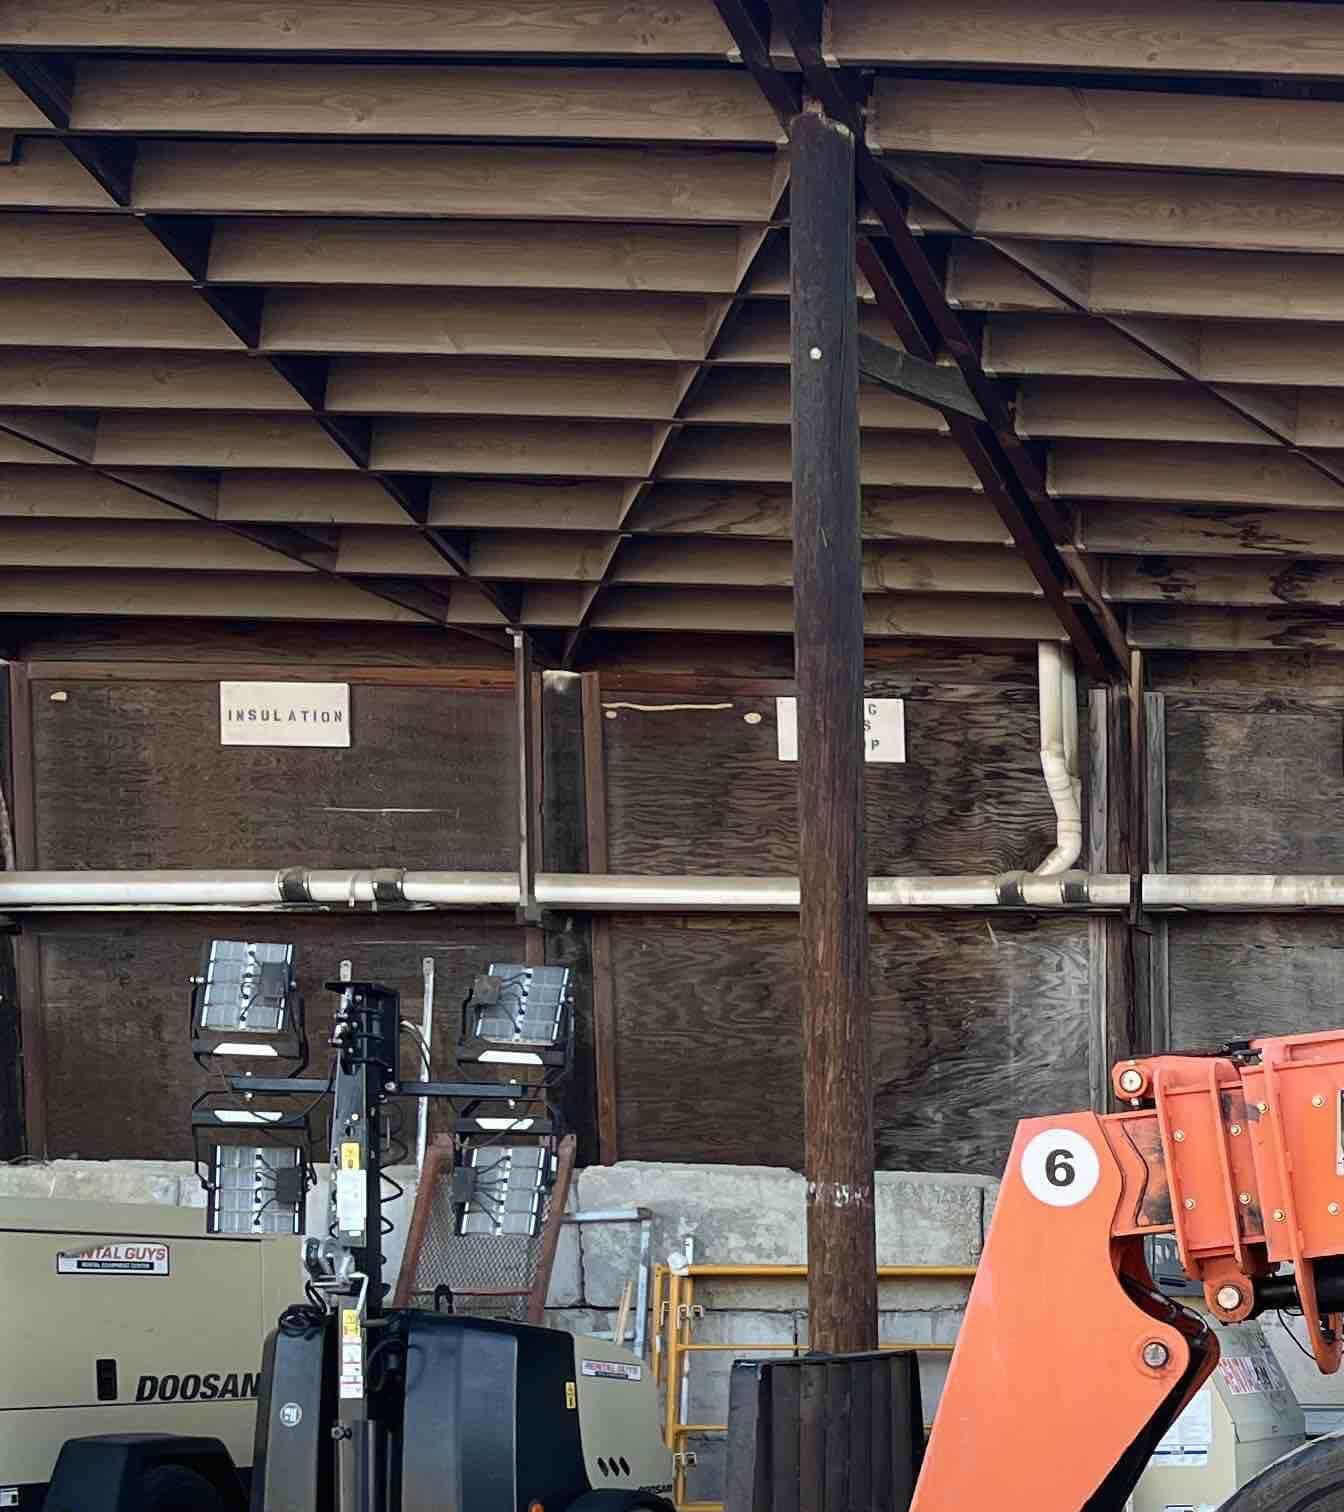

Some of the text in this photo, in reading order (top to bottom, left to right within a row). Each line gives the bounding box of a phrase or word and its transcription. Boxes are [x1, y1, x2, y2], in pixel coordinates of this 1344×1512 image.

[227, 709, 343, 723] INSULATION
[1045, 1148, 1076, 1188] 6
[124, 1247, 167, 1260] GUYS
[135, 1372, 261, 1402] DOOSAN
